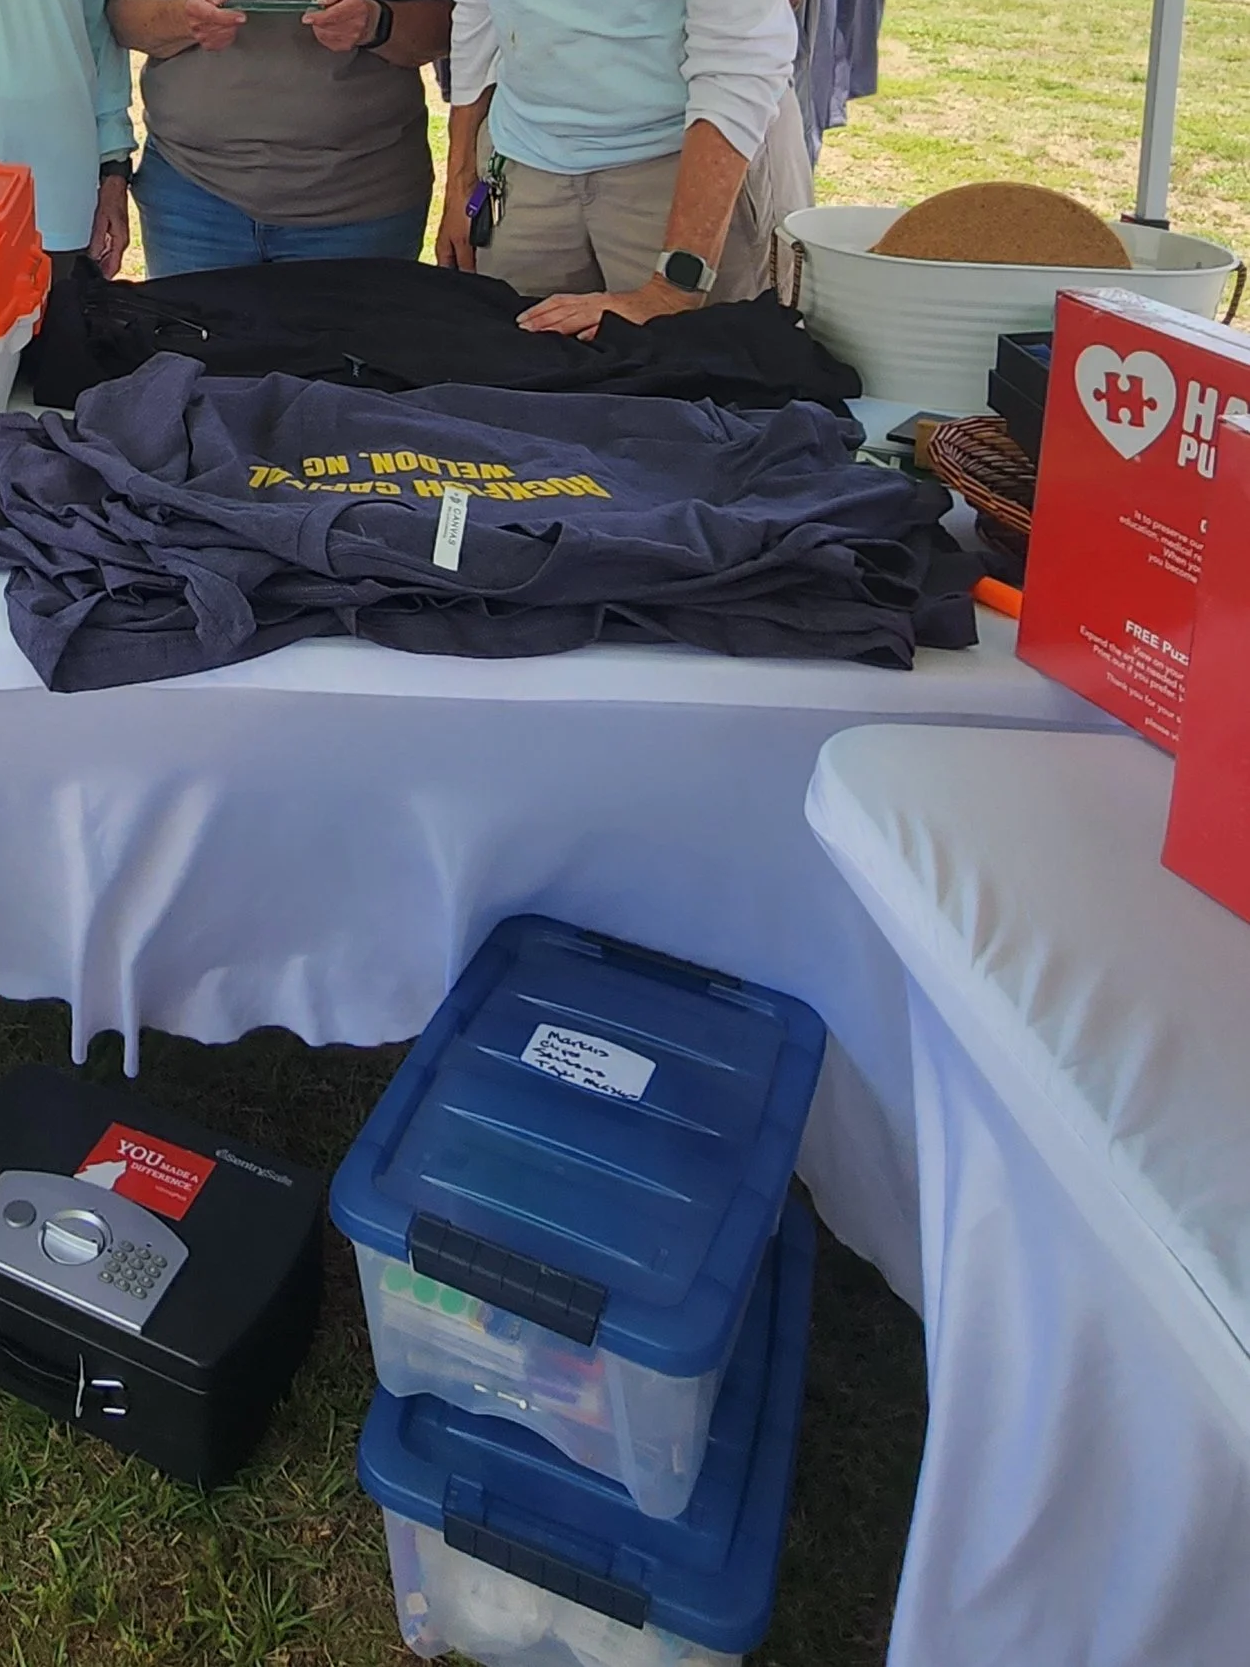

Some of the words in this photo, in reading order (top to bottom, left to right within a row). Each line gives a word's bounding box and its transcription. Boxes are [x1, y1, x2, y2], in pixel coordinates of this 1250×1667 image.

[302, 454, 350, 477] NC
[1142, 514, 1152, 526] to
[1152, 520, 1189, 544] preserve
[1189, 538, 1205, 551] our
[1160, 536, 1193, 558] medical
[1148, 553, 1164, 567] you
[1164, 559, 1199, 585] become
[1163, 546, 1187, 567] When
[1079, 624, 1109, 649] Expand
[1108, 642, 1123, 657] the
[1146, 665, 1178, 690] needed
[1125, 619, 1160, 650] FREE
[1162, 640, 1191, 667] Puz
[1093, 643, 1112, 662] Print
[1111, 657, 1127, 671] out
[1134, 669, 1150, 685] you
[1152, 657, 1165, 670] on
[1106, 671, 1129, 692] Thank
[1129, 686, 1144, 702] you
[1144, 694, 1157, 709] for
[1157, 704, 1176, 720] your
[1144, 716, 1171, 737] please
[117, 1138, 165, 1167] YOU
[159, 1161, 191, 1181] MADE
[190, 1174, 200, 1184] A
[226, 1152, 294, 1188] SentrySafe
